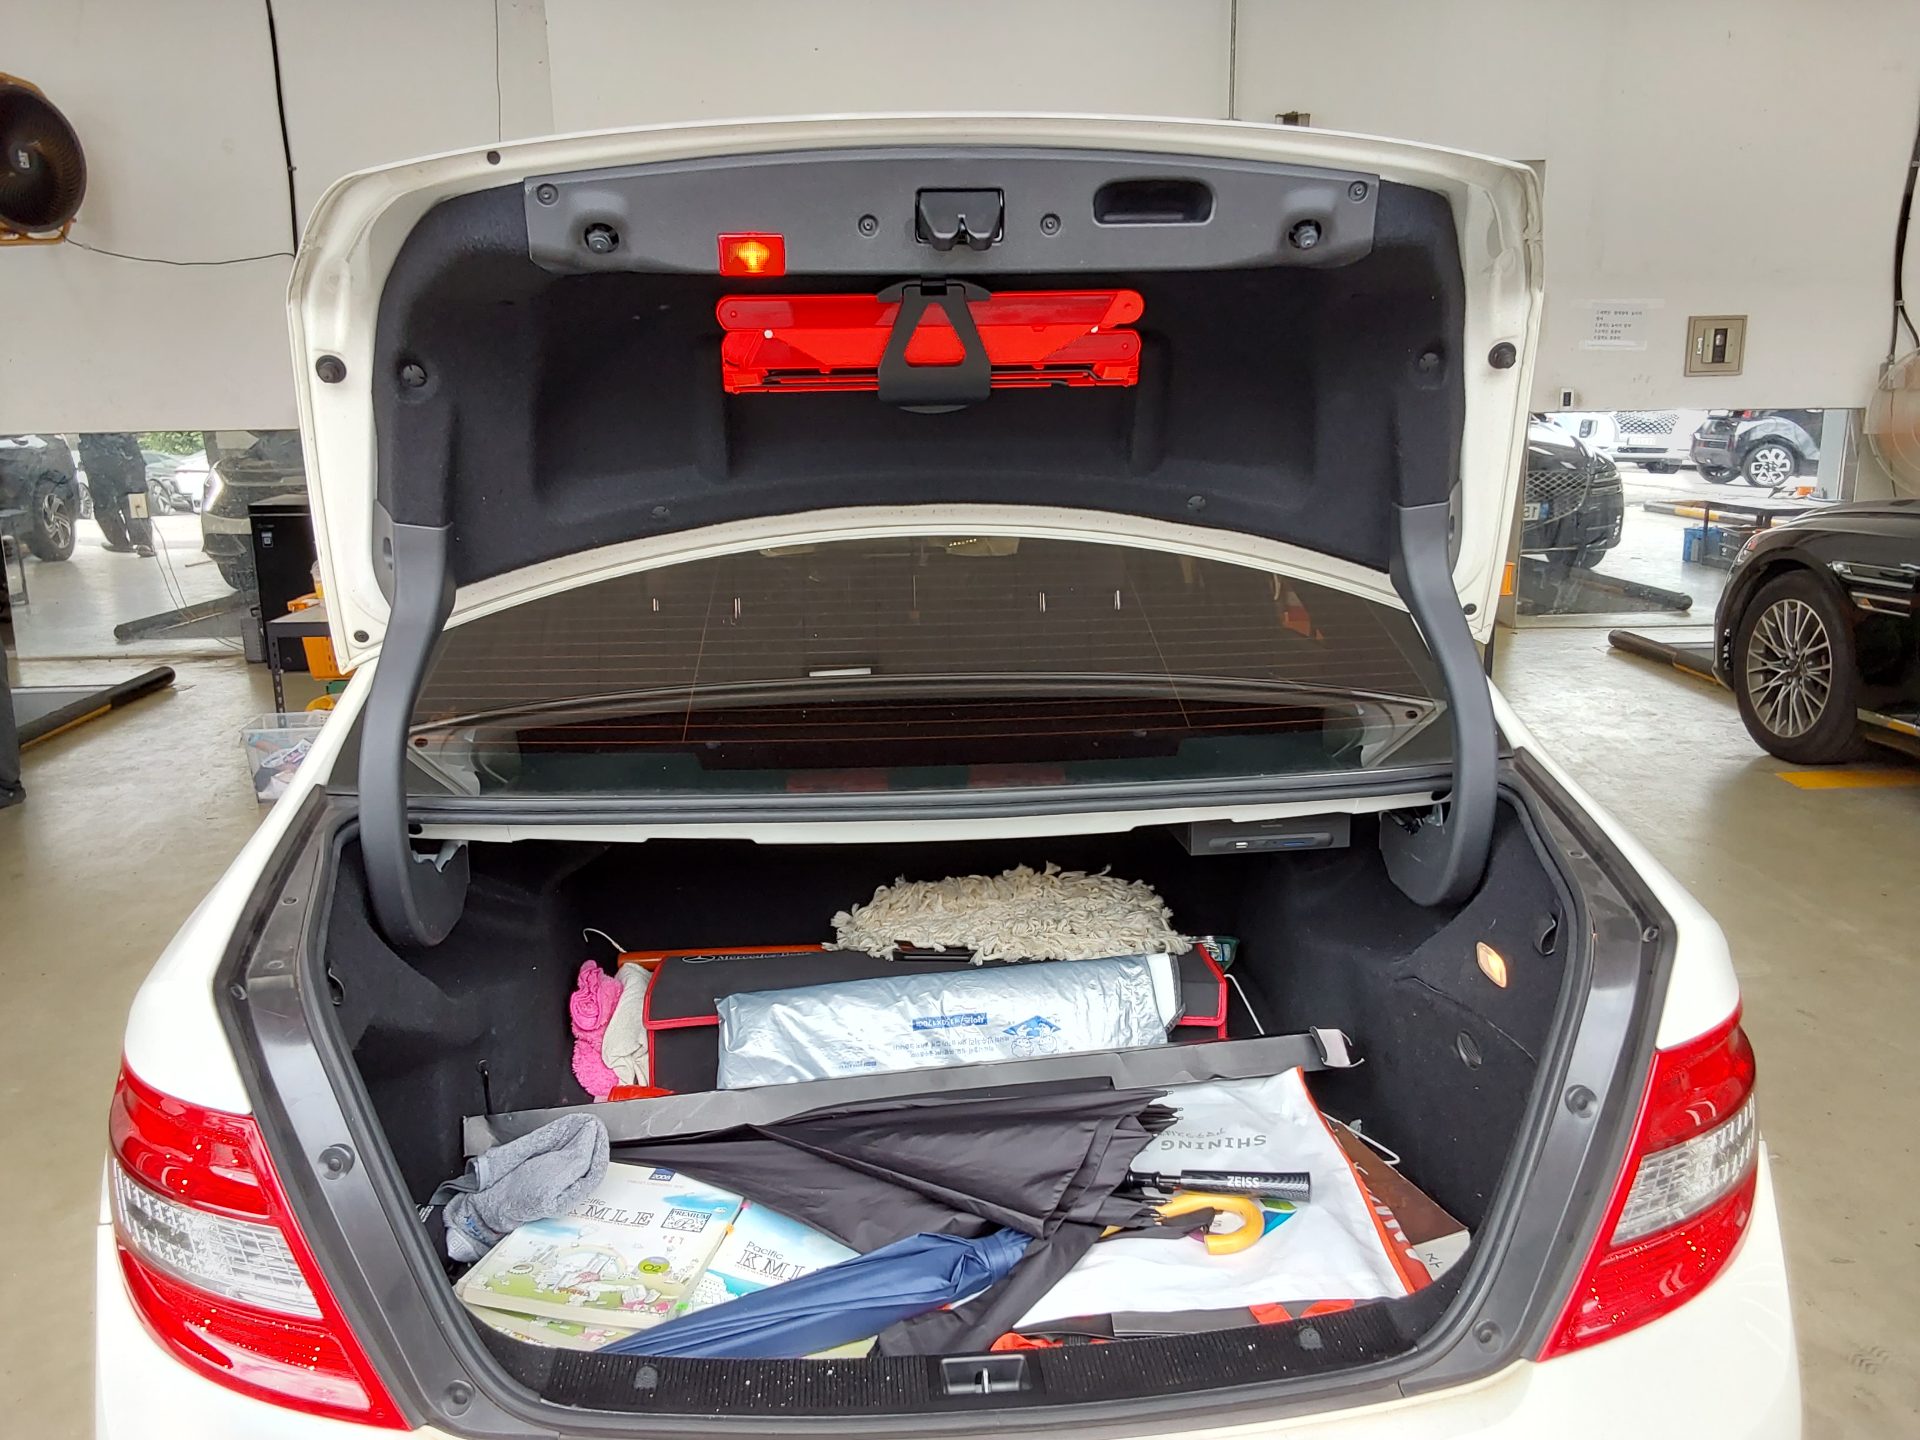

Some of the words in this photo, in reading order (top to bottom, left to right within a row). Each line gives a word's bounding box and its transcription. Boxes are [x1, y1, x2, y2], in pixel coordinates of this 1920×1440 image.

[1161, 1135, 1267, 1150] SHINING
[1227, 1176, 1260, 1188] ZEISS
[670, 1210, 710, 1219] PREMIUM
[746, 1241, 784, 1260] Pacific
